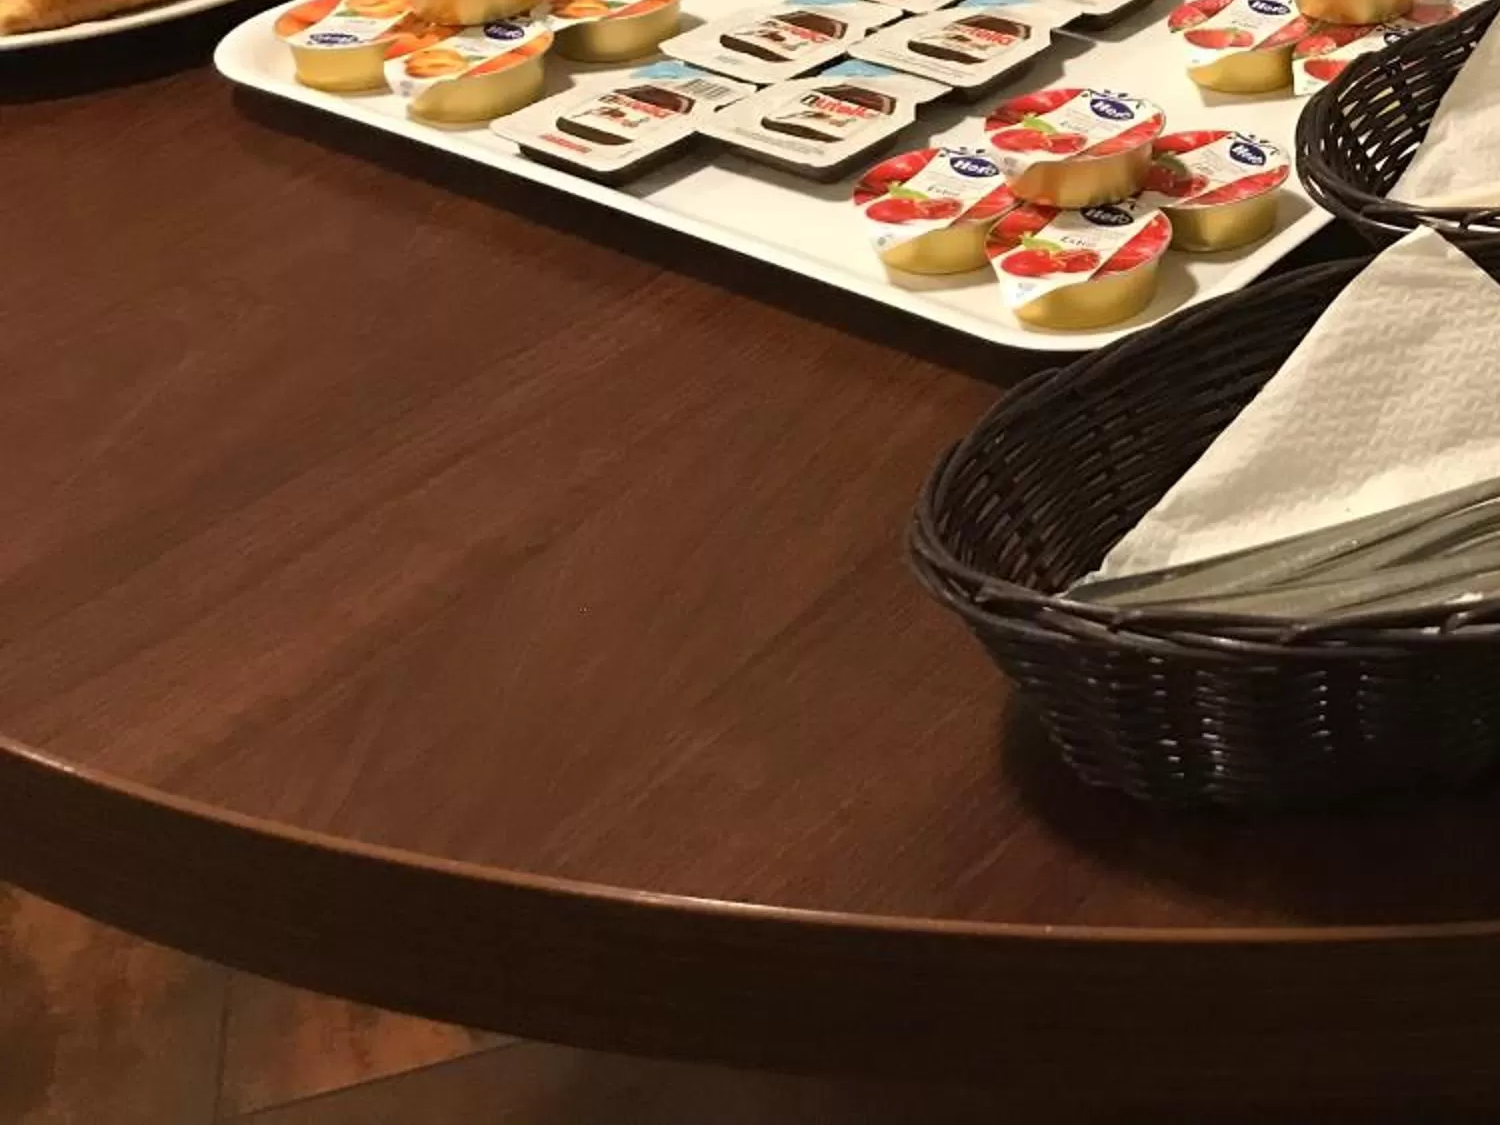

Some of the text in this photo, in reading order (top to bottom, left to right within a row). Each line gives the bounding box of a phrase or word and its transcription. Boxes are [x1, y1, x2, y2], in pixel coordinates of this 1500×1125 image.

[1093, 97, 1133, 120] Hero
[954, 159, 999, 175] Hero
[1086, 208, 1132, 225] Hero
